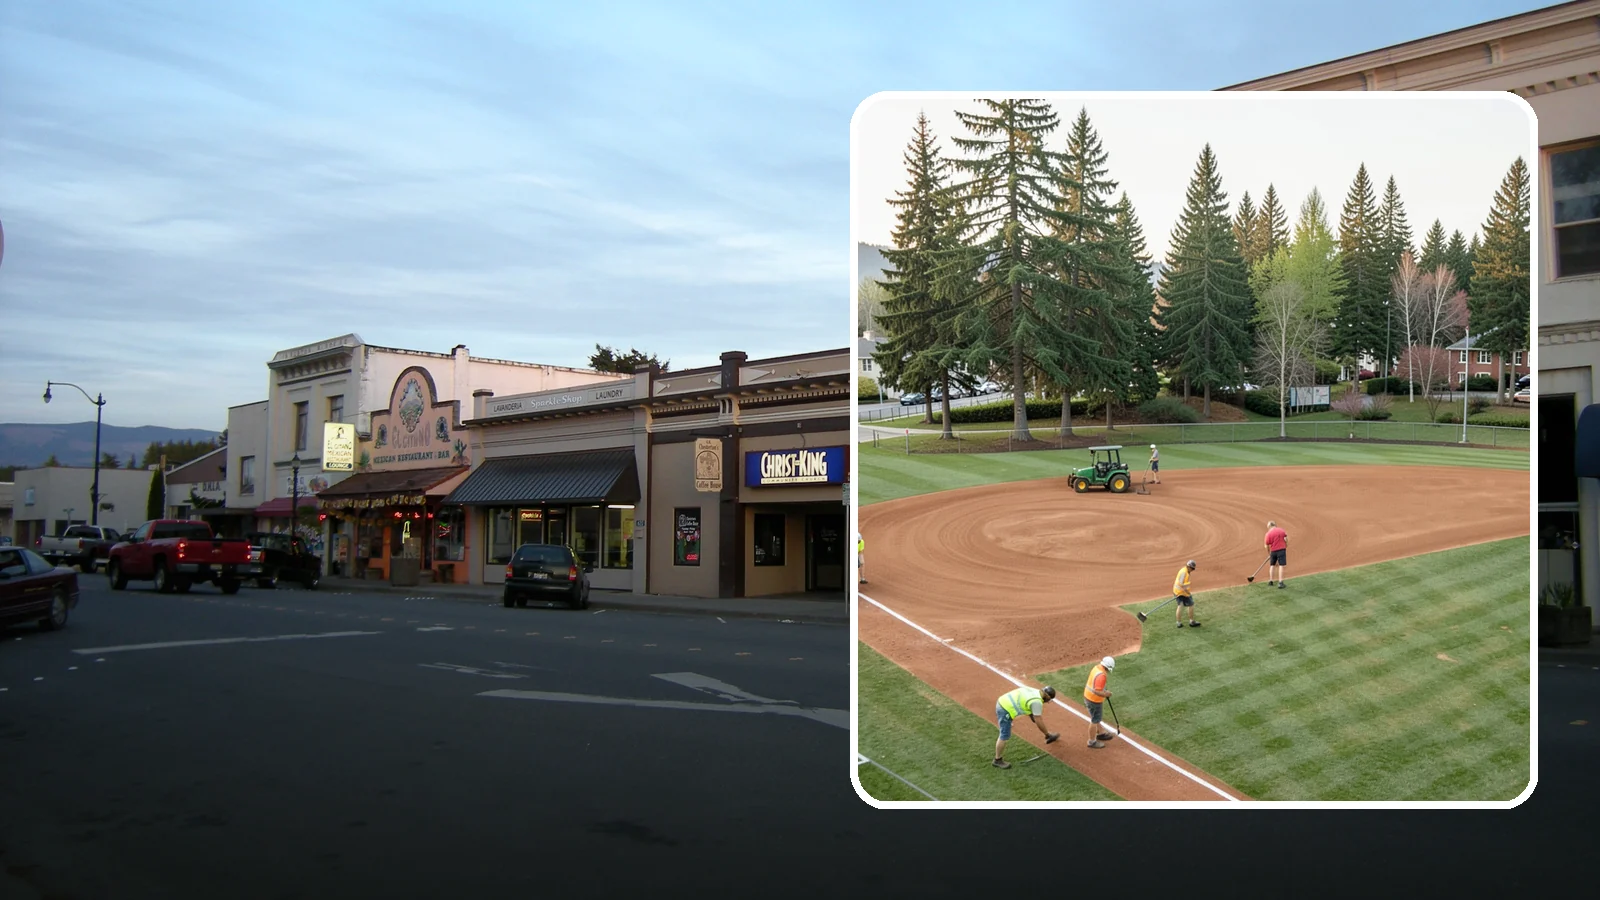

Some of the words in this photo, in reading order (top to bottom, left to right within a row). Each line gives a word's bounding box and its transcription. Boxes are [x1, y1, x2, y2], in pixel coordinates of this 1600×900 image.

[530, 397, 560, 409] Sparkle
[562, 394, 582, 405] Shop
[595, 389, 623, 400] LAUNDRY
[493, 402, 522, 413] LAVANDERIA
[373, 455, 396, 464] MEXICAN
[398, 451, 433, 462] RESTAURANT
[438, 450, 450, 459] BAR
[760, 452, 797, 478] CHRIST
[799, 450, 827, 476] KING
